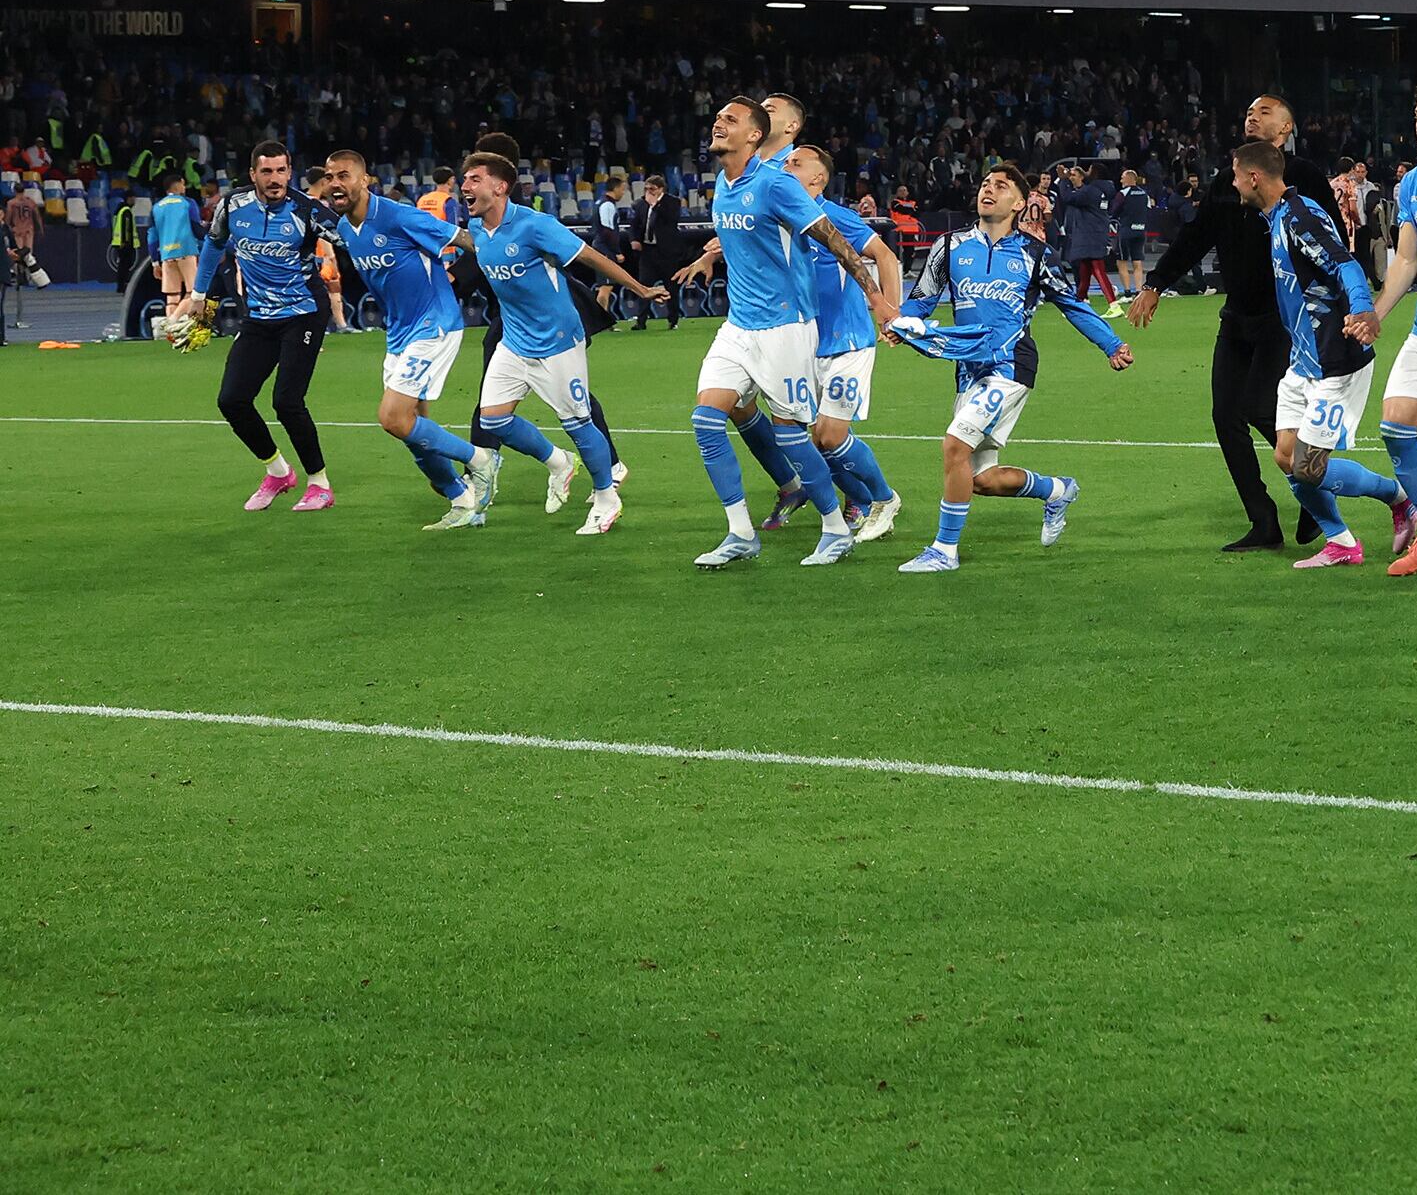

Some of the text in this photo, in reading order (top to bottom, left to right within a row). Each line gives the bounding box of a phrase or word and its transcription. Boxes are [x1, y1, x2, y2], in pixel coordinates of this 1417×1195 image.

[93, 10, 125, 36] THE
[126, 10, 185, 37] WORLD
[236, 220, 251, 229] EA7
[721, 212, 756, 231] MSC
[238, 237, 292, 257] Coca-Cola
[359, 253, 396, 271] MSC
[958, 257, 974, 266] EA7
[486, 263, 527, 281] MSC
[958, 276, 1020, 302] Coca-Cola
[400, 355, 433, 381] 37
[569, 377, 584, 403] 6
[783, 377, 808, 404] 16
[829, 376, 859, 402] 68
[970, 383, 1004, 413] 29
[794, 405, 809, 413] EA7
[840, 401, 854, 409] EA7
[1310, 398, 1345, 431] 30
[957, 422, 976, 435] EA7
